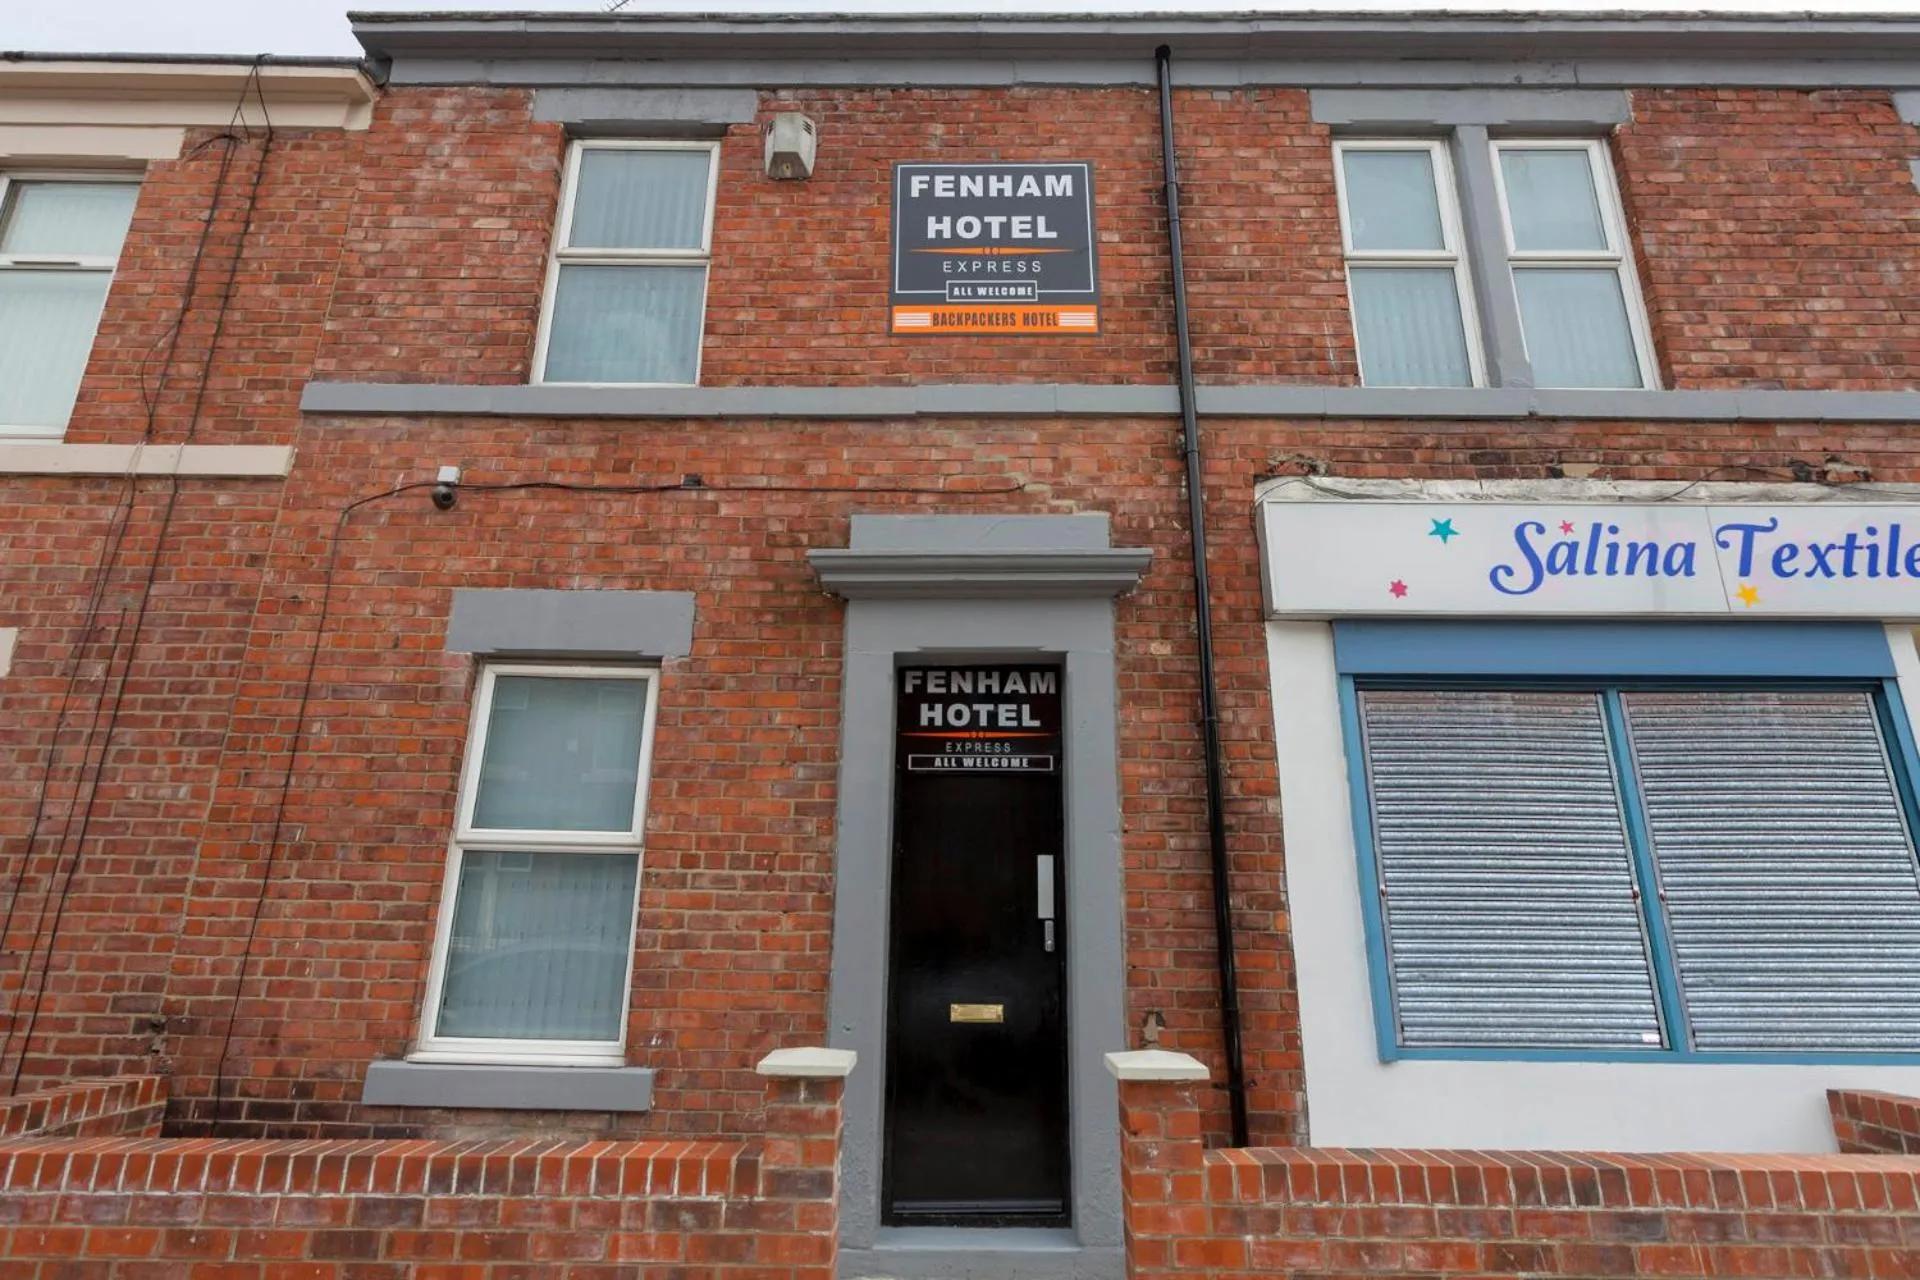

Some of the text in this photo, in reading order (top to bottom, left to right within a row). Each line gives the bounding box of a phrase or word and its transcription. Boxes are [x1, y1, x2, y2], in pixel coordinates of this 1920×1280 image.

[910, 174, 1073, 198] FENHAM
[927, 215, 1058, 239] HOTEL
[943, 260, 1042, 273] EXPRESS
[953, 286, 1033, 296] ALL WELCOME
[932, 312, 1059, 326] BACKPACKERS HOTEL
[1489, 520, 1696, 595] Salina
[904, 671, 1056, 694] FENHAM
[920, 703, 1041, 727] HOTEL
[945, 742, 1012, 753] EXPRESS
[934, 757, 1029, 768] ALL WELCOME
